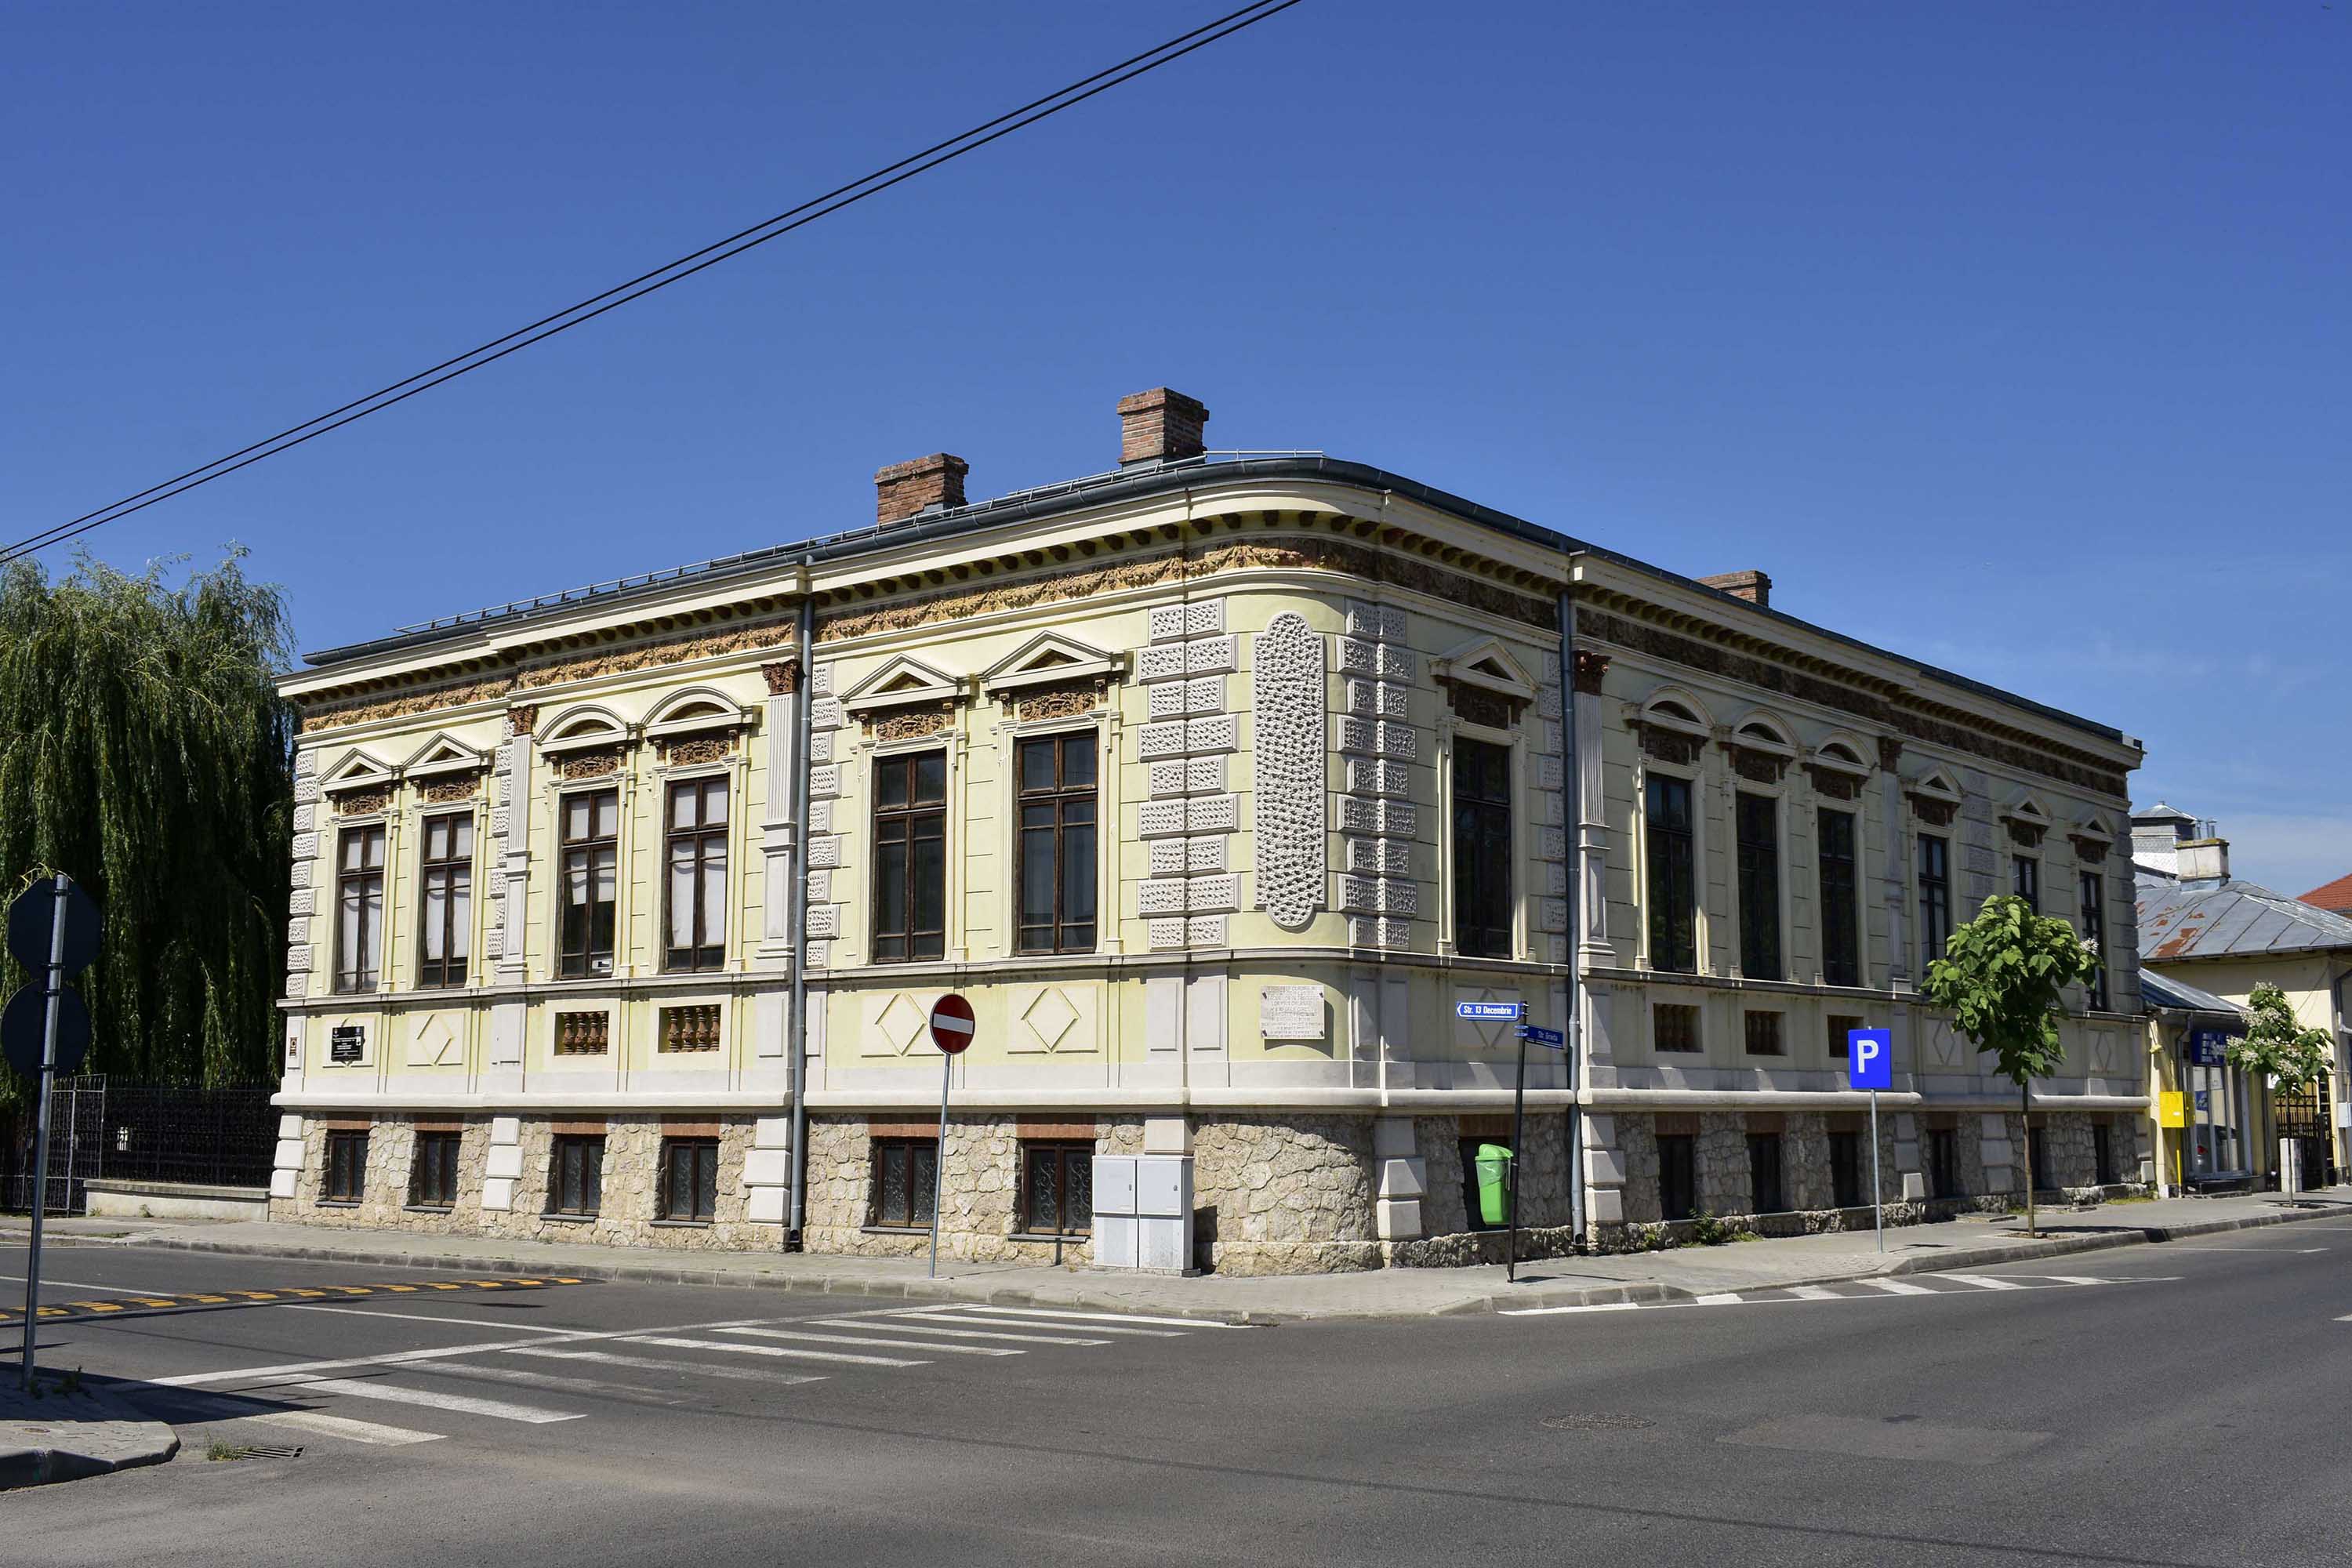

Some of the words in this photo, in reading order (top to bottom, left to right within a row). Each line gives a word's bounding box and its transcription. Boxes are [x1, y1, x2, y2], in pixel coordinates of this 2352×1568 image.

[1464, 1005, 1473, 1014] Str.
[1483, 1006, 1512, 1014] Decembrie
[1857, 1040, 1879, 1073] P
